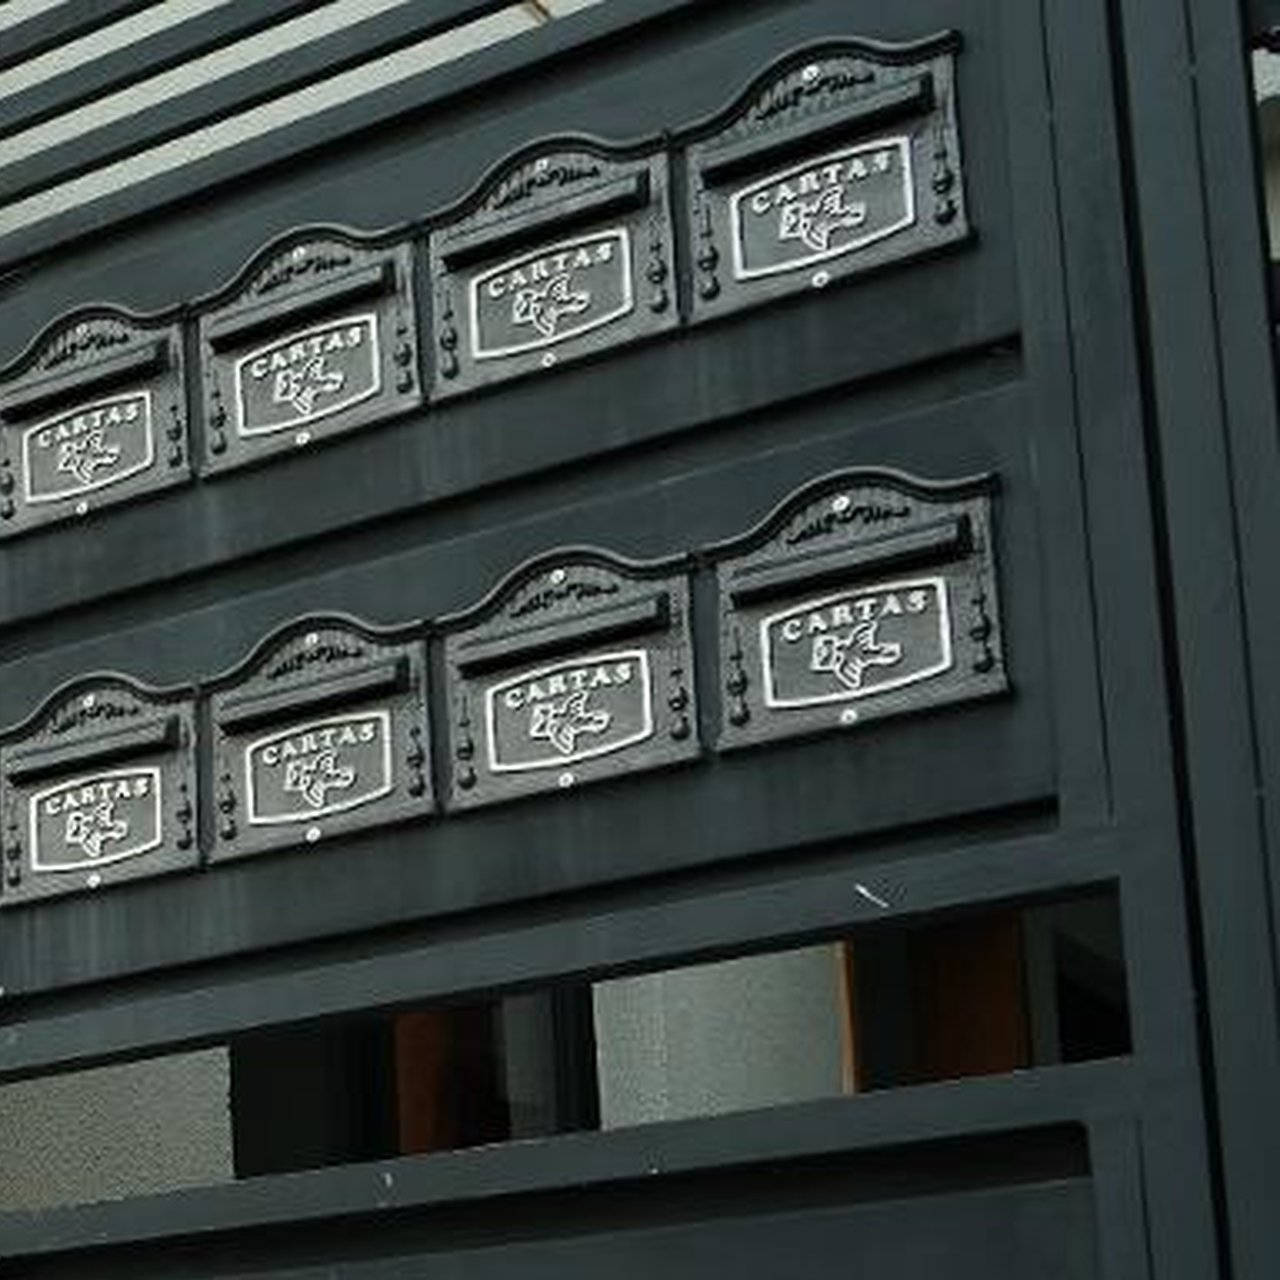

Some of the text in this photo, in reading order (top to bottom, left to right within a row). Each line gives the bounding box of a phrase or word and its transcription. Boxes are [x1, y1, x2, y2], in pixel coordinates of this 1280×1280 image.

[751, 151, 892, 214] CARTAS
[487, 242, 614, 298] CARTAS
[250, 325, 363, 378] CARTAS
[39, 402, 140, 448] CARTAS
[781, 589, 929, 641] CARTAS
[503, 661, 634, 709] CARTAS
[261, 722, 376, 765] CARTAS
[44, 777, 149, 815] CARTAS
